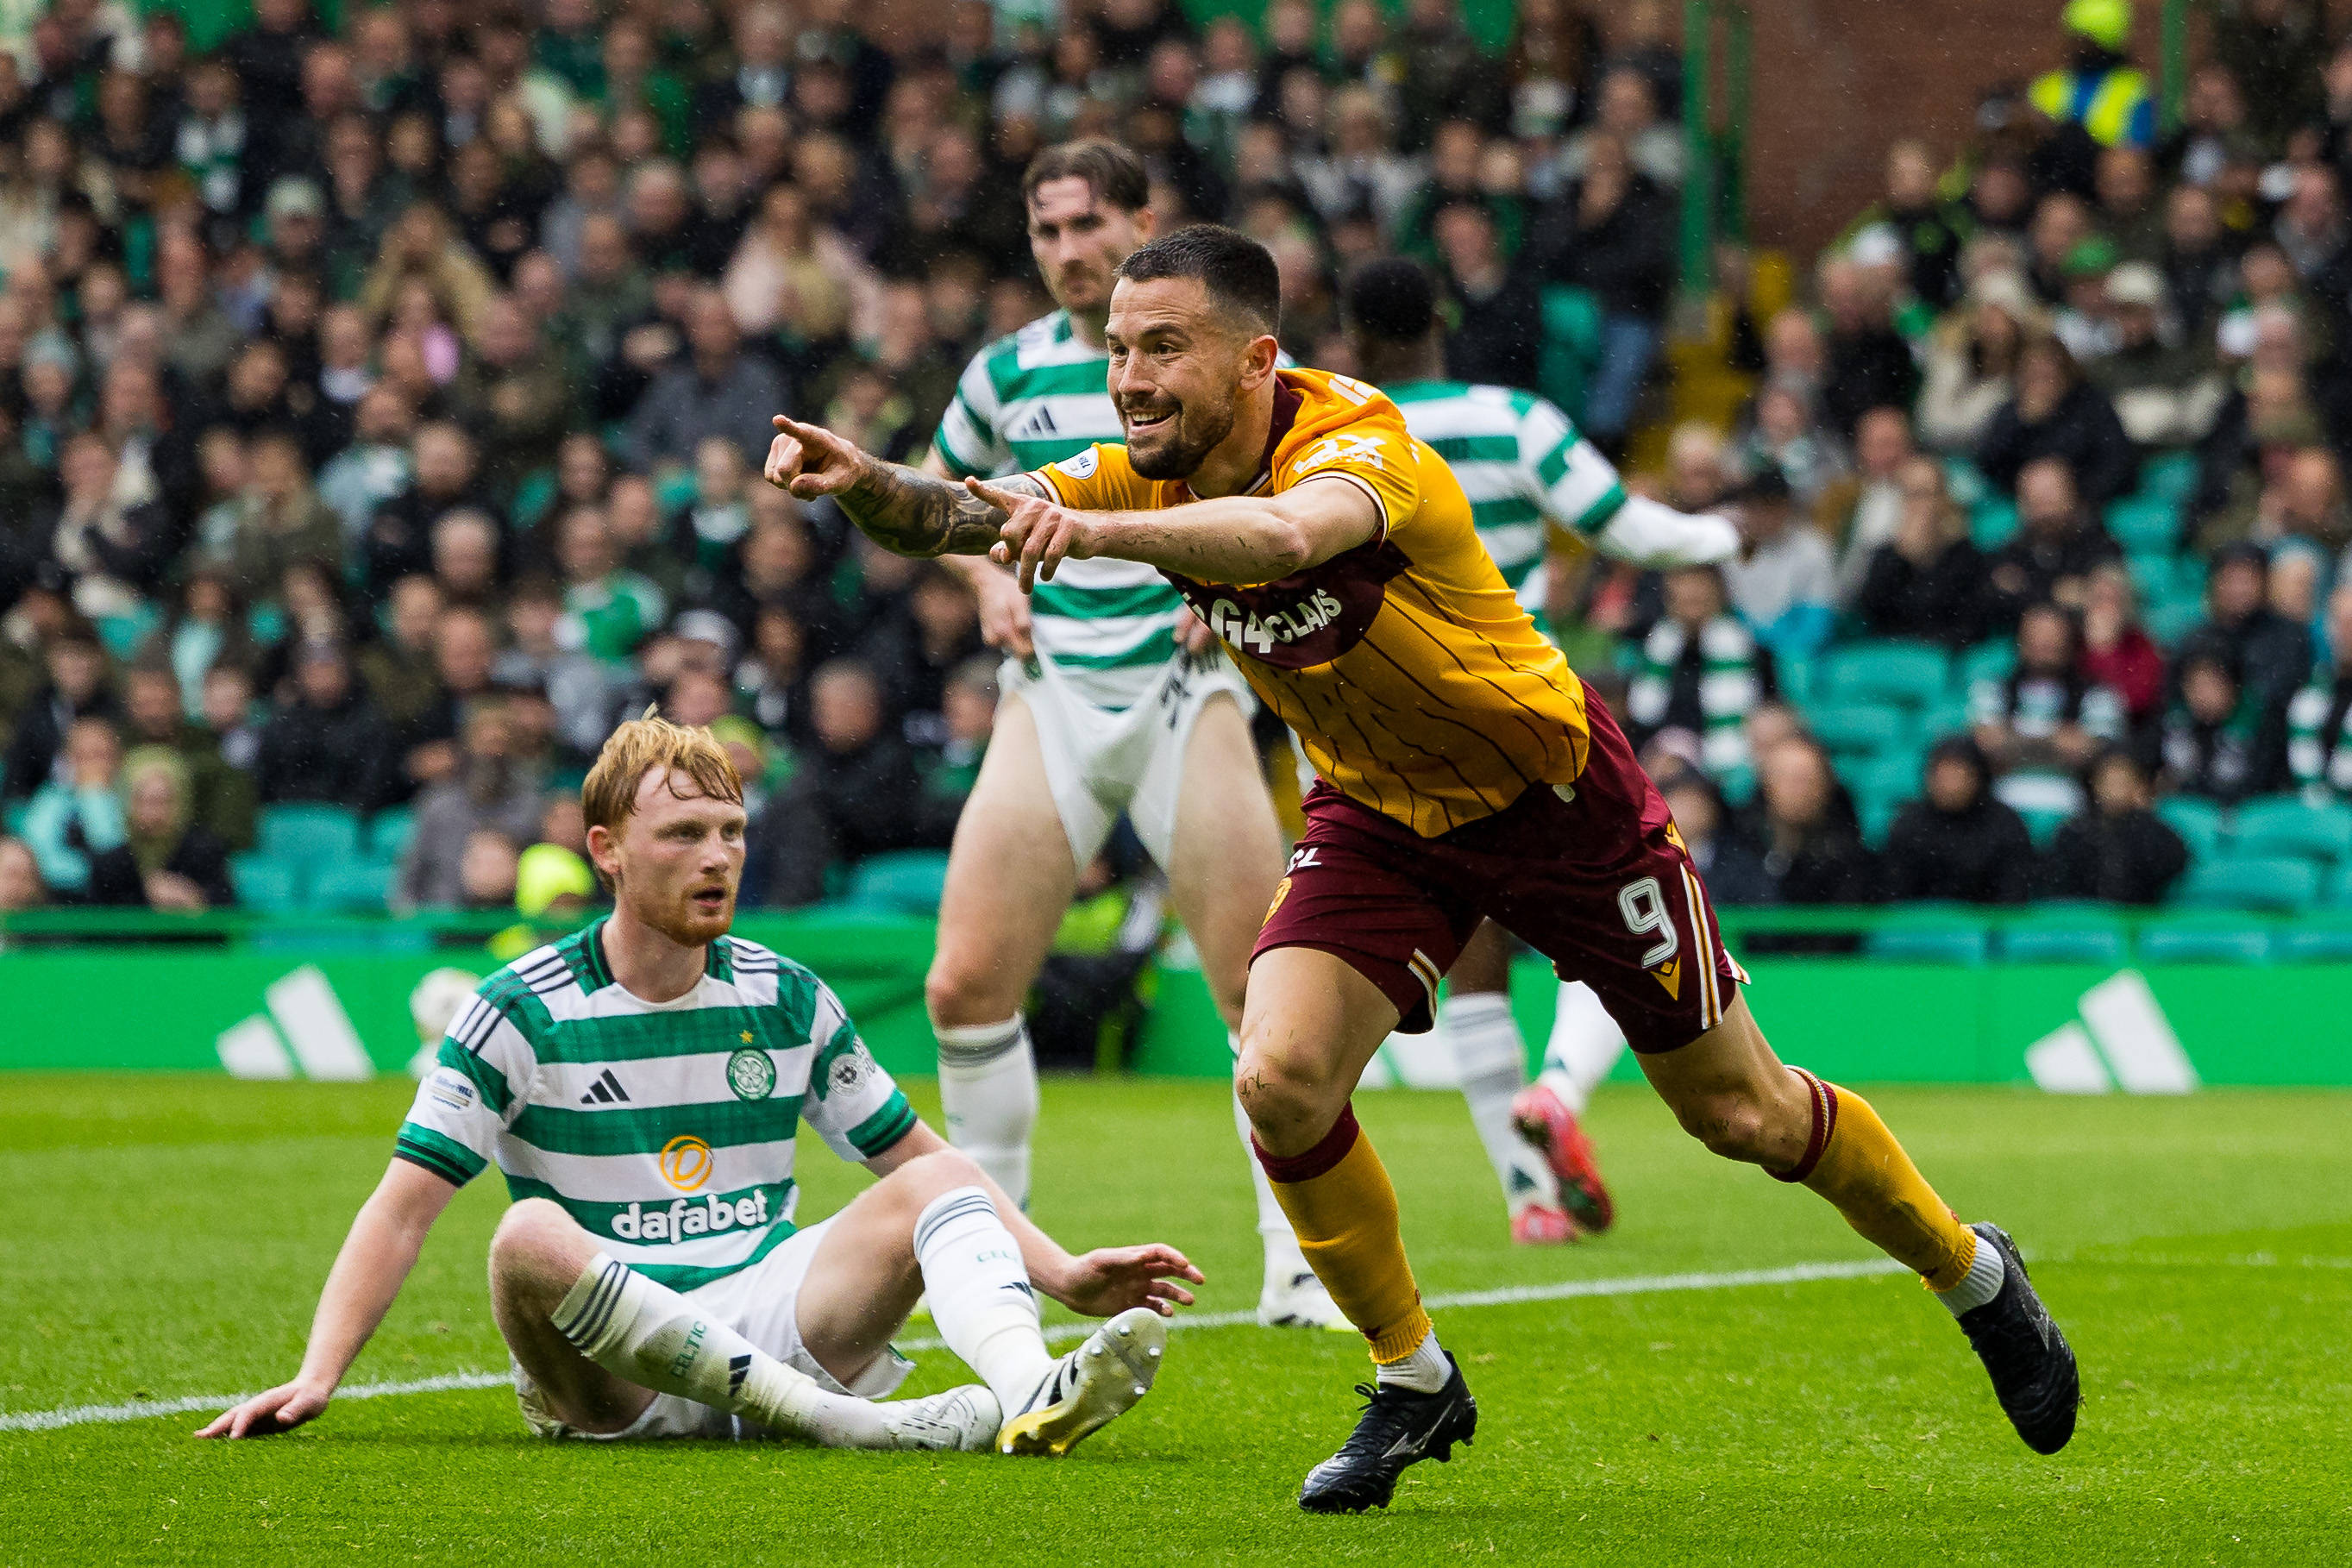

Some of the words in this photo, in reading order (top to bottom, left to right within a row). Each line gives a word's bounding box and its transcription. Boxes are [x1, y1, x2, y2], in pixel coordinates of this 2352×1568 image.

[1617, 875, 1678, 969] 9
[611, 1189, 768, 1245] dafabet
[669, 1320, 707, 1378] CELTIC
